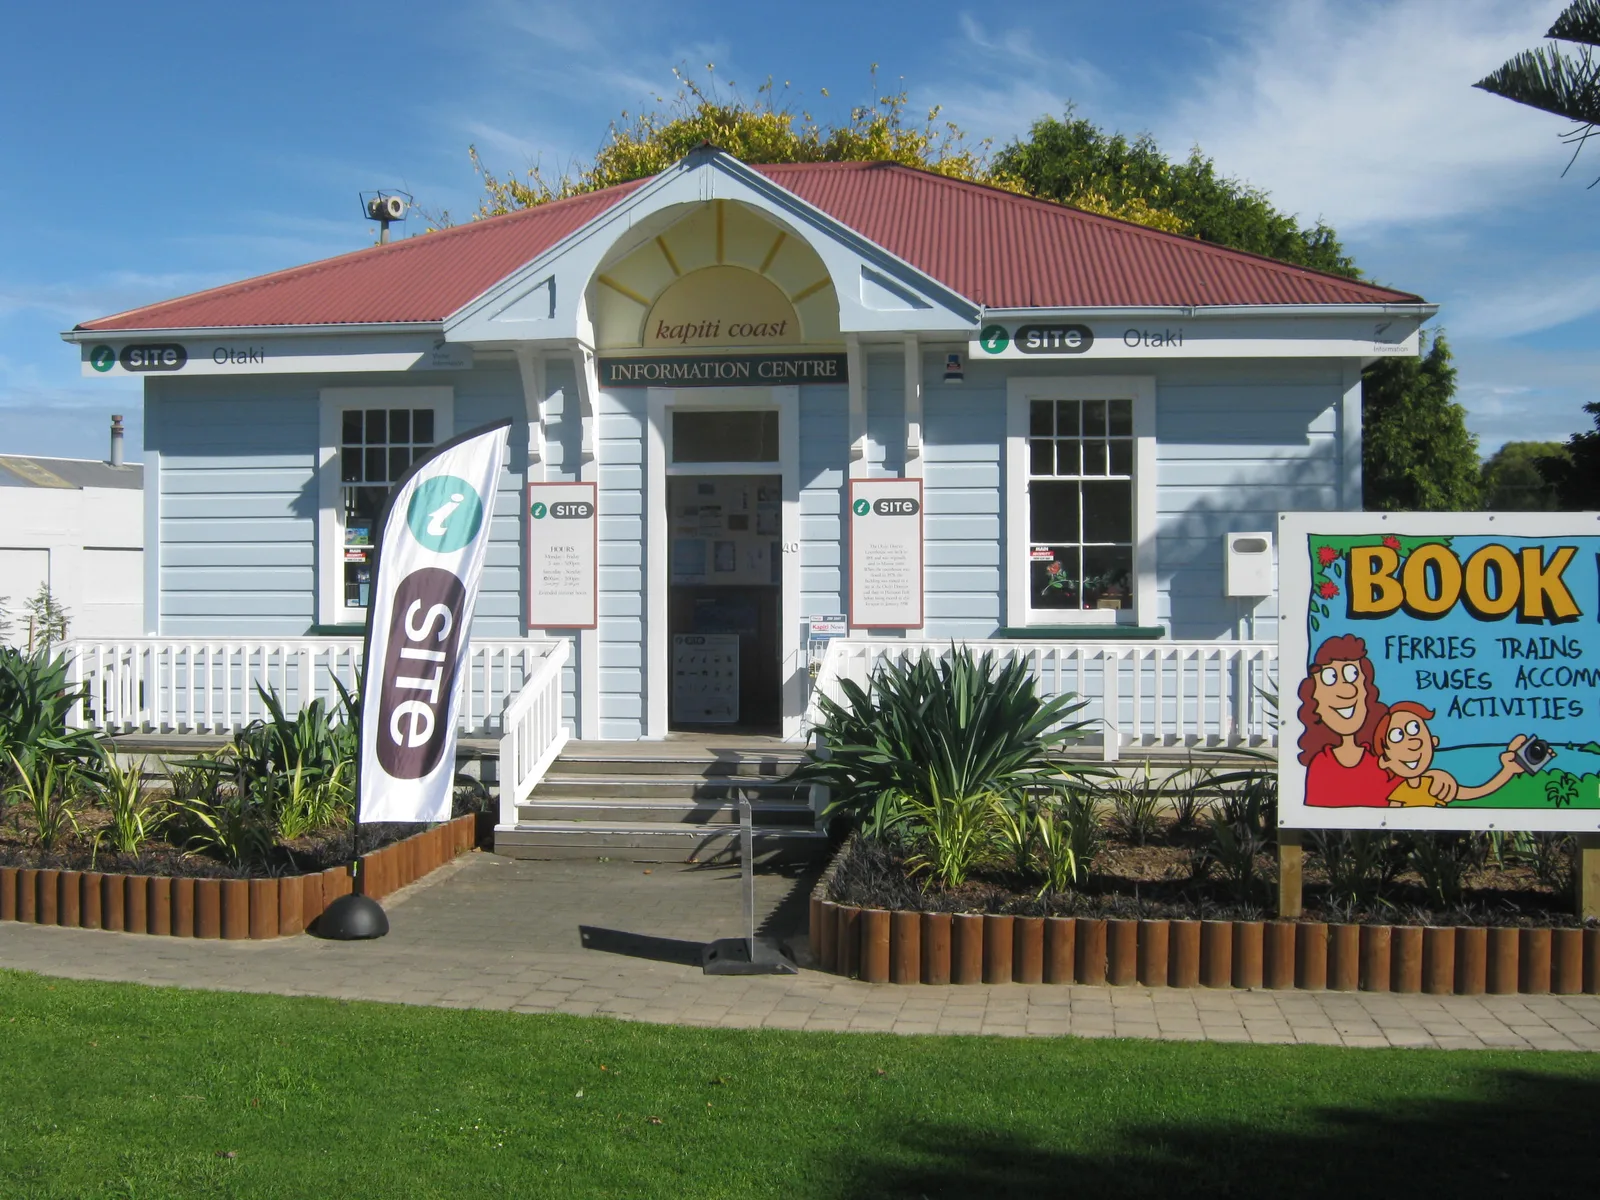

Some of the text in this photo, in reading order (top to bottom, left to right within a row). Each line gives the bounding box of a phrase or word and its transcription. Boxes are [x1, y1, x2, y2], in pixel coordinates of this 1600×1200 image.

[655, 319, 788, 345] kapiti coast
[1123, 328, 1184, 347] Otaki
[212, 346, 265, 365] Otaki
[1373, 345, 1409, 353] Information
[610, 359, 837, 381] INFORMATION CENTRE
[1347, 543, 1583, 624] BOOK
[812, 623, 829, 631] Kapiti
[1384, 634, 1583, 663] FERRIES TRAINS
[1415, 668, 1493, 690] BUSES
[1447, 694, 1584, 720] ACTIVITIES
